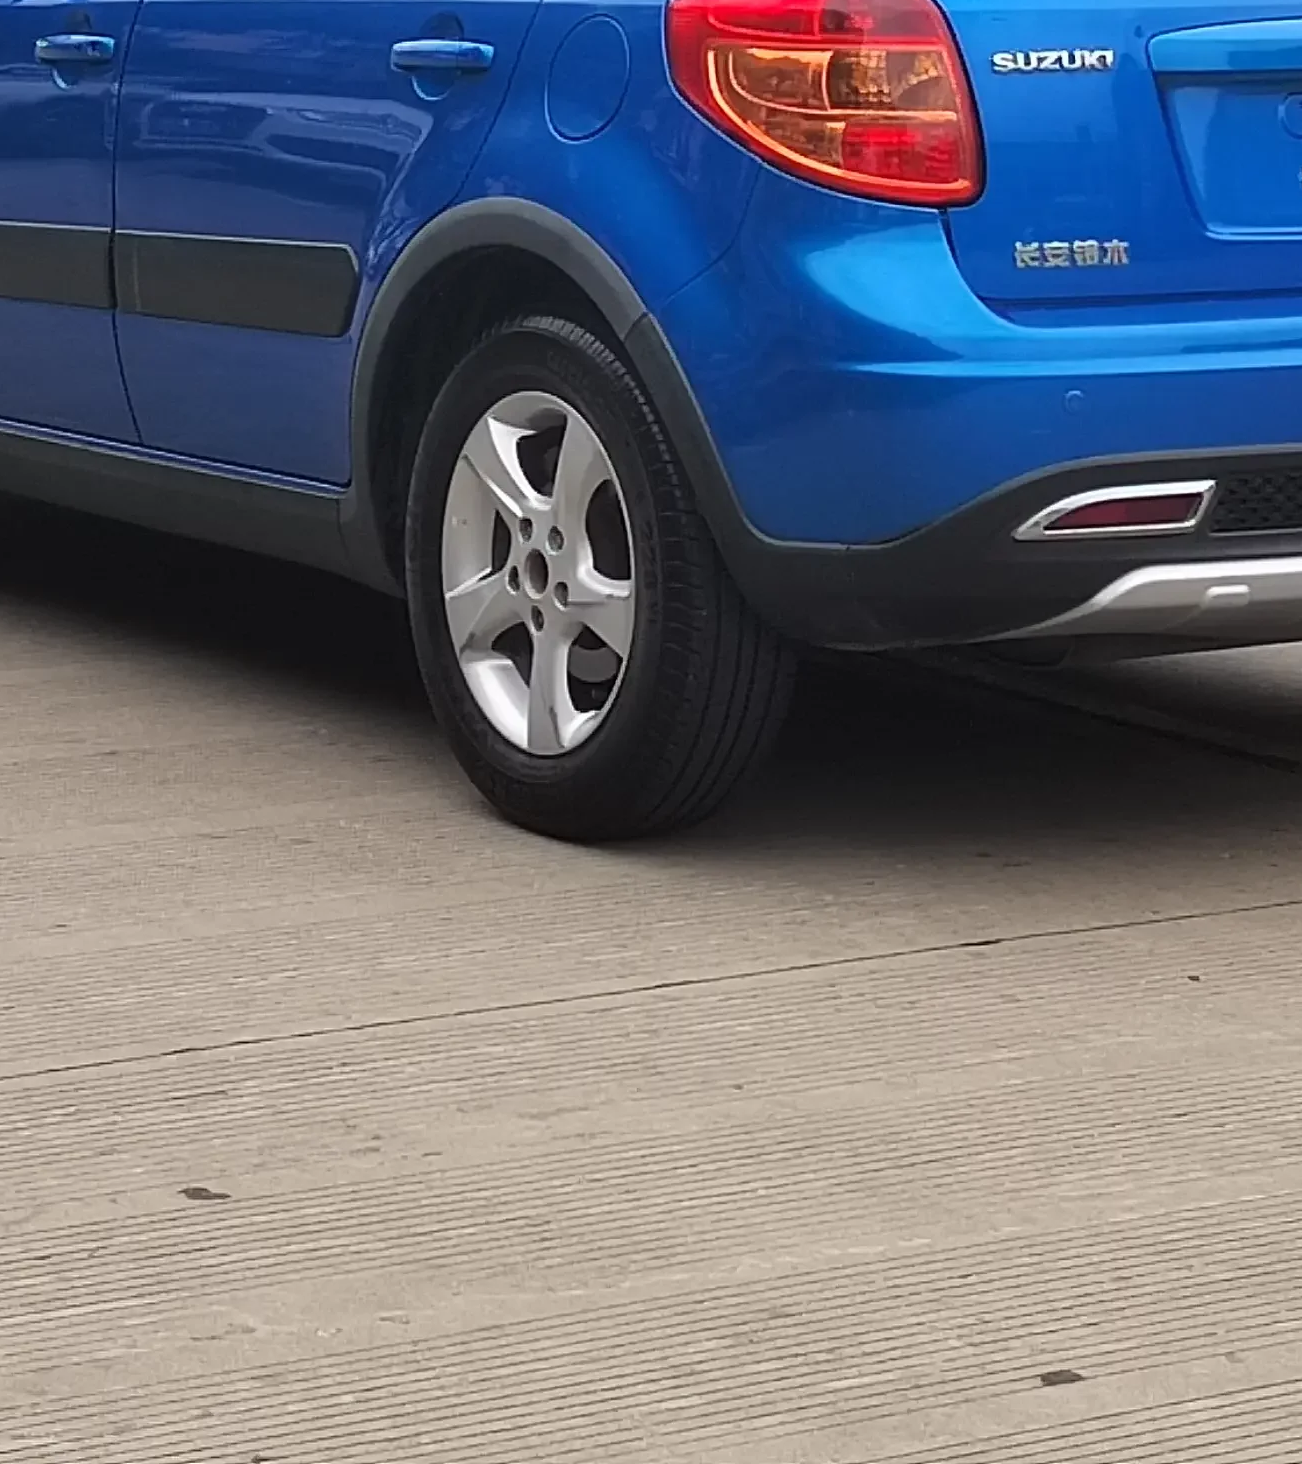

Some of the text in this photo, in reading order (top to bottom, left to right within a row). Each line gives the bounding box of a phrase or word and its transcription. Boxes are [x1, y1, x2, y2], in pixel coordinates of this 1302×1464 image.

[992, 49, 1114, 72] SUZUKI
[1015, 239, 1130, 269] 长安铃木
